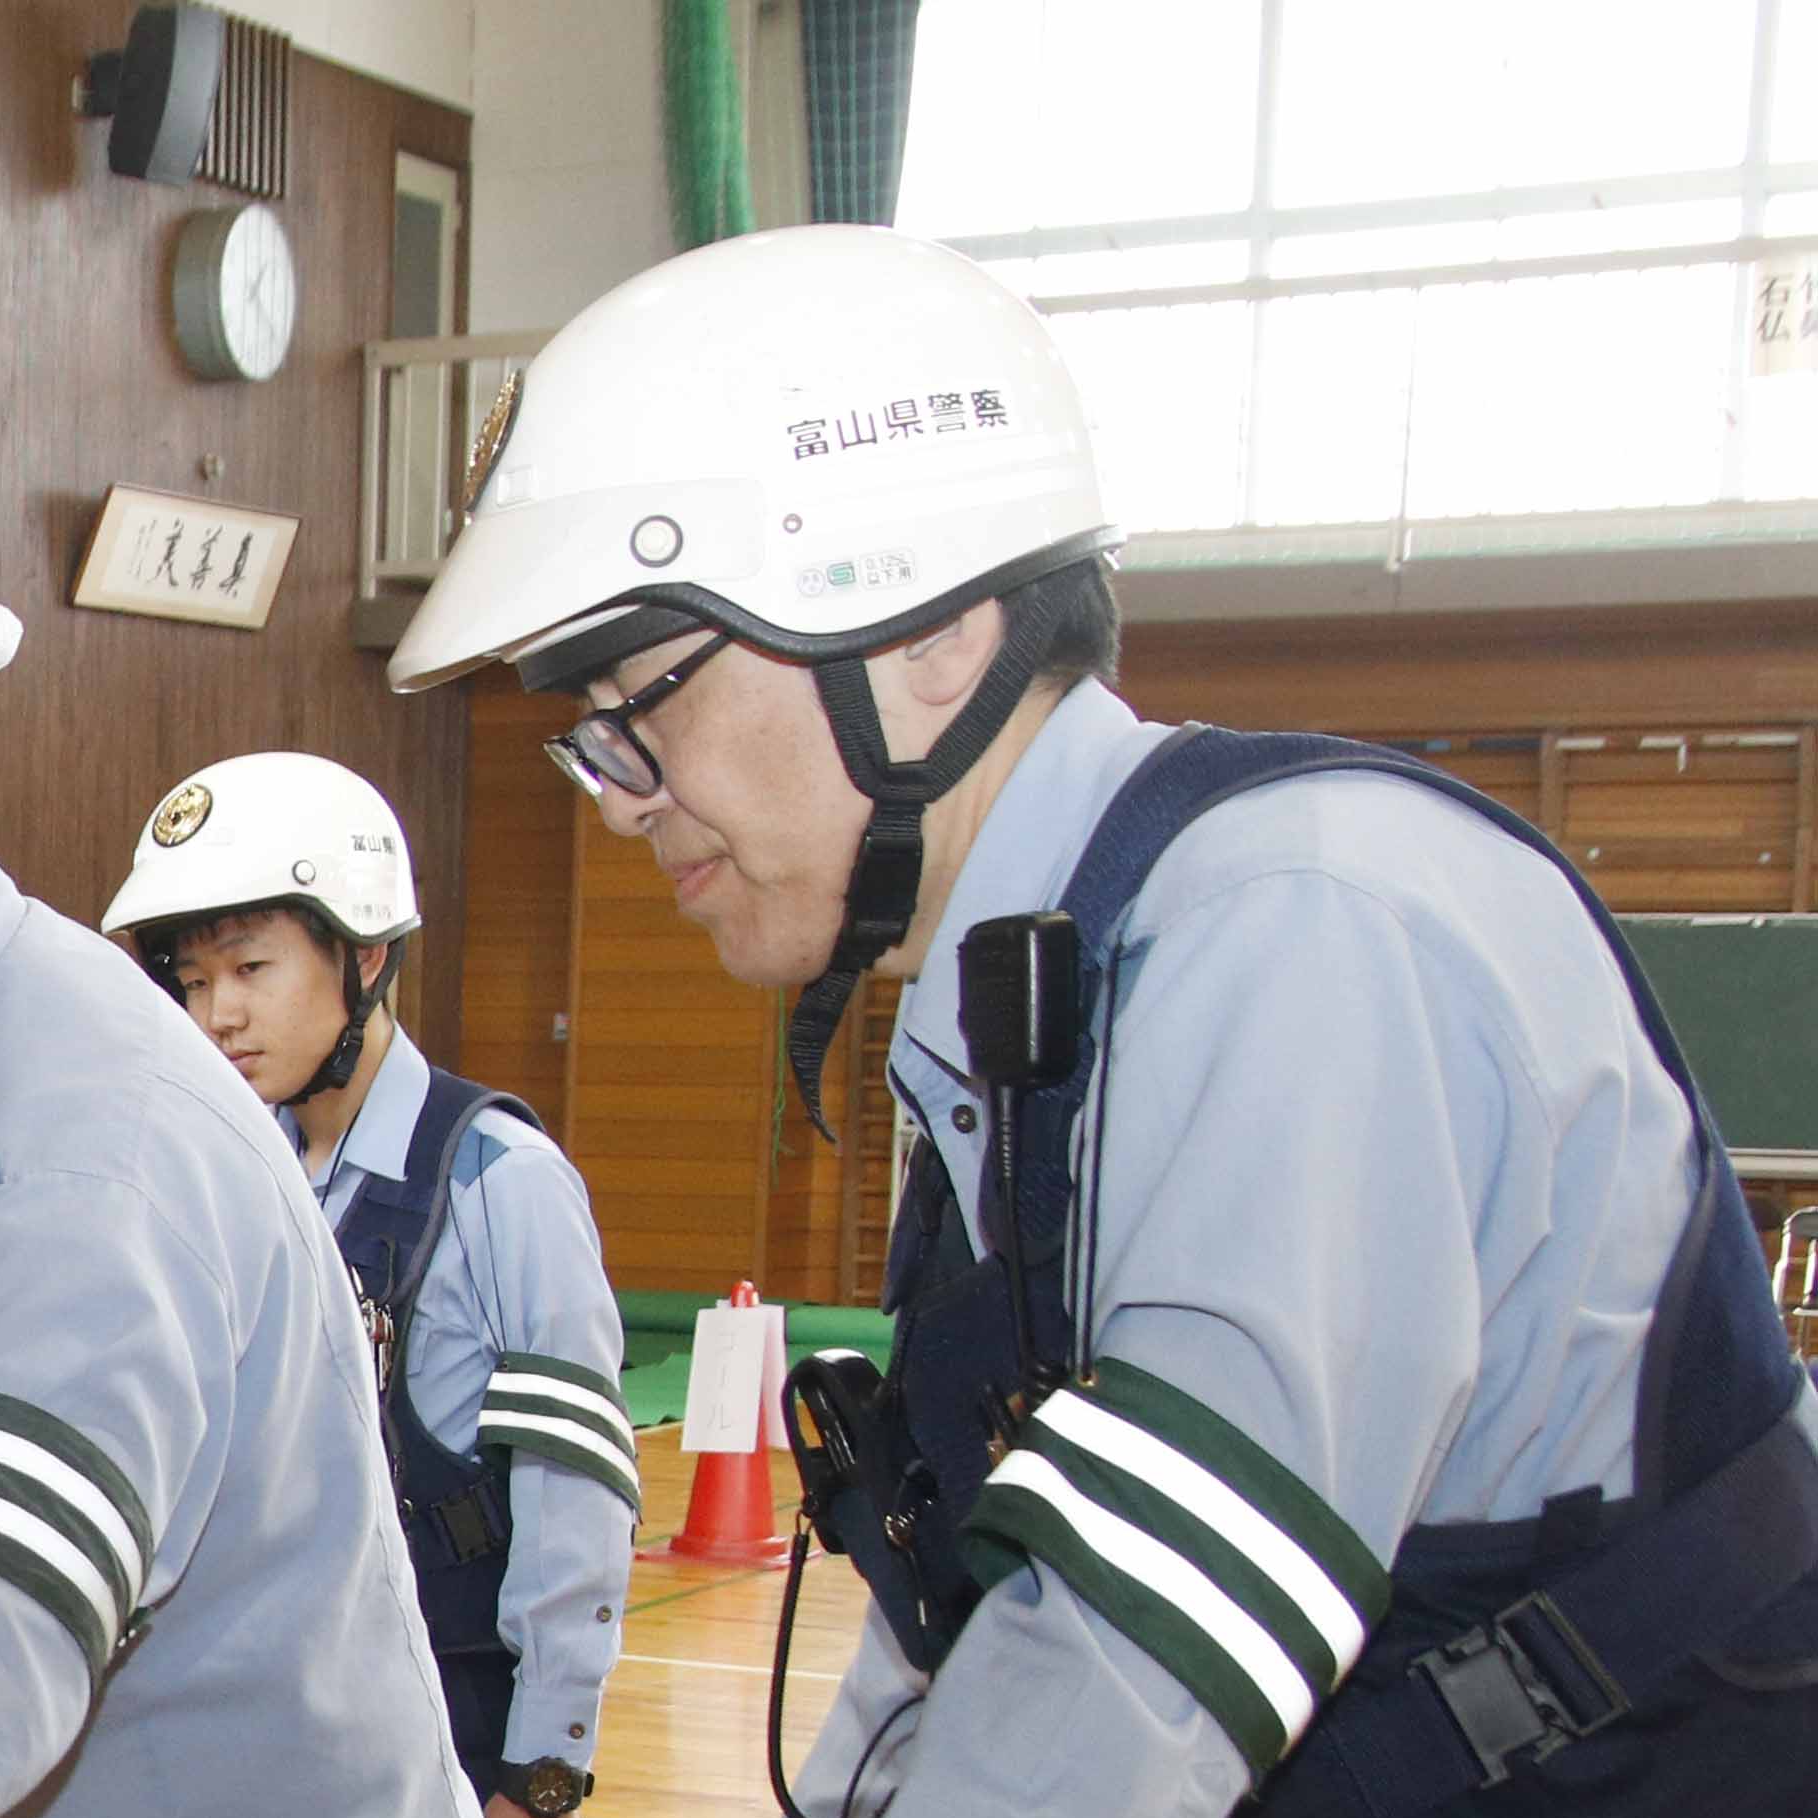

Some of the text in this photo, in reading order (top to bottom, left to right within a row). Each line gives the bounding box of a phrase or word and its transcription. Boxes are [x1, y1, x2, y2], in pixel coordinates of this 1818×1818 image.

[787, 388, 1009, 460] 富山県警察
